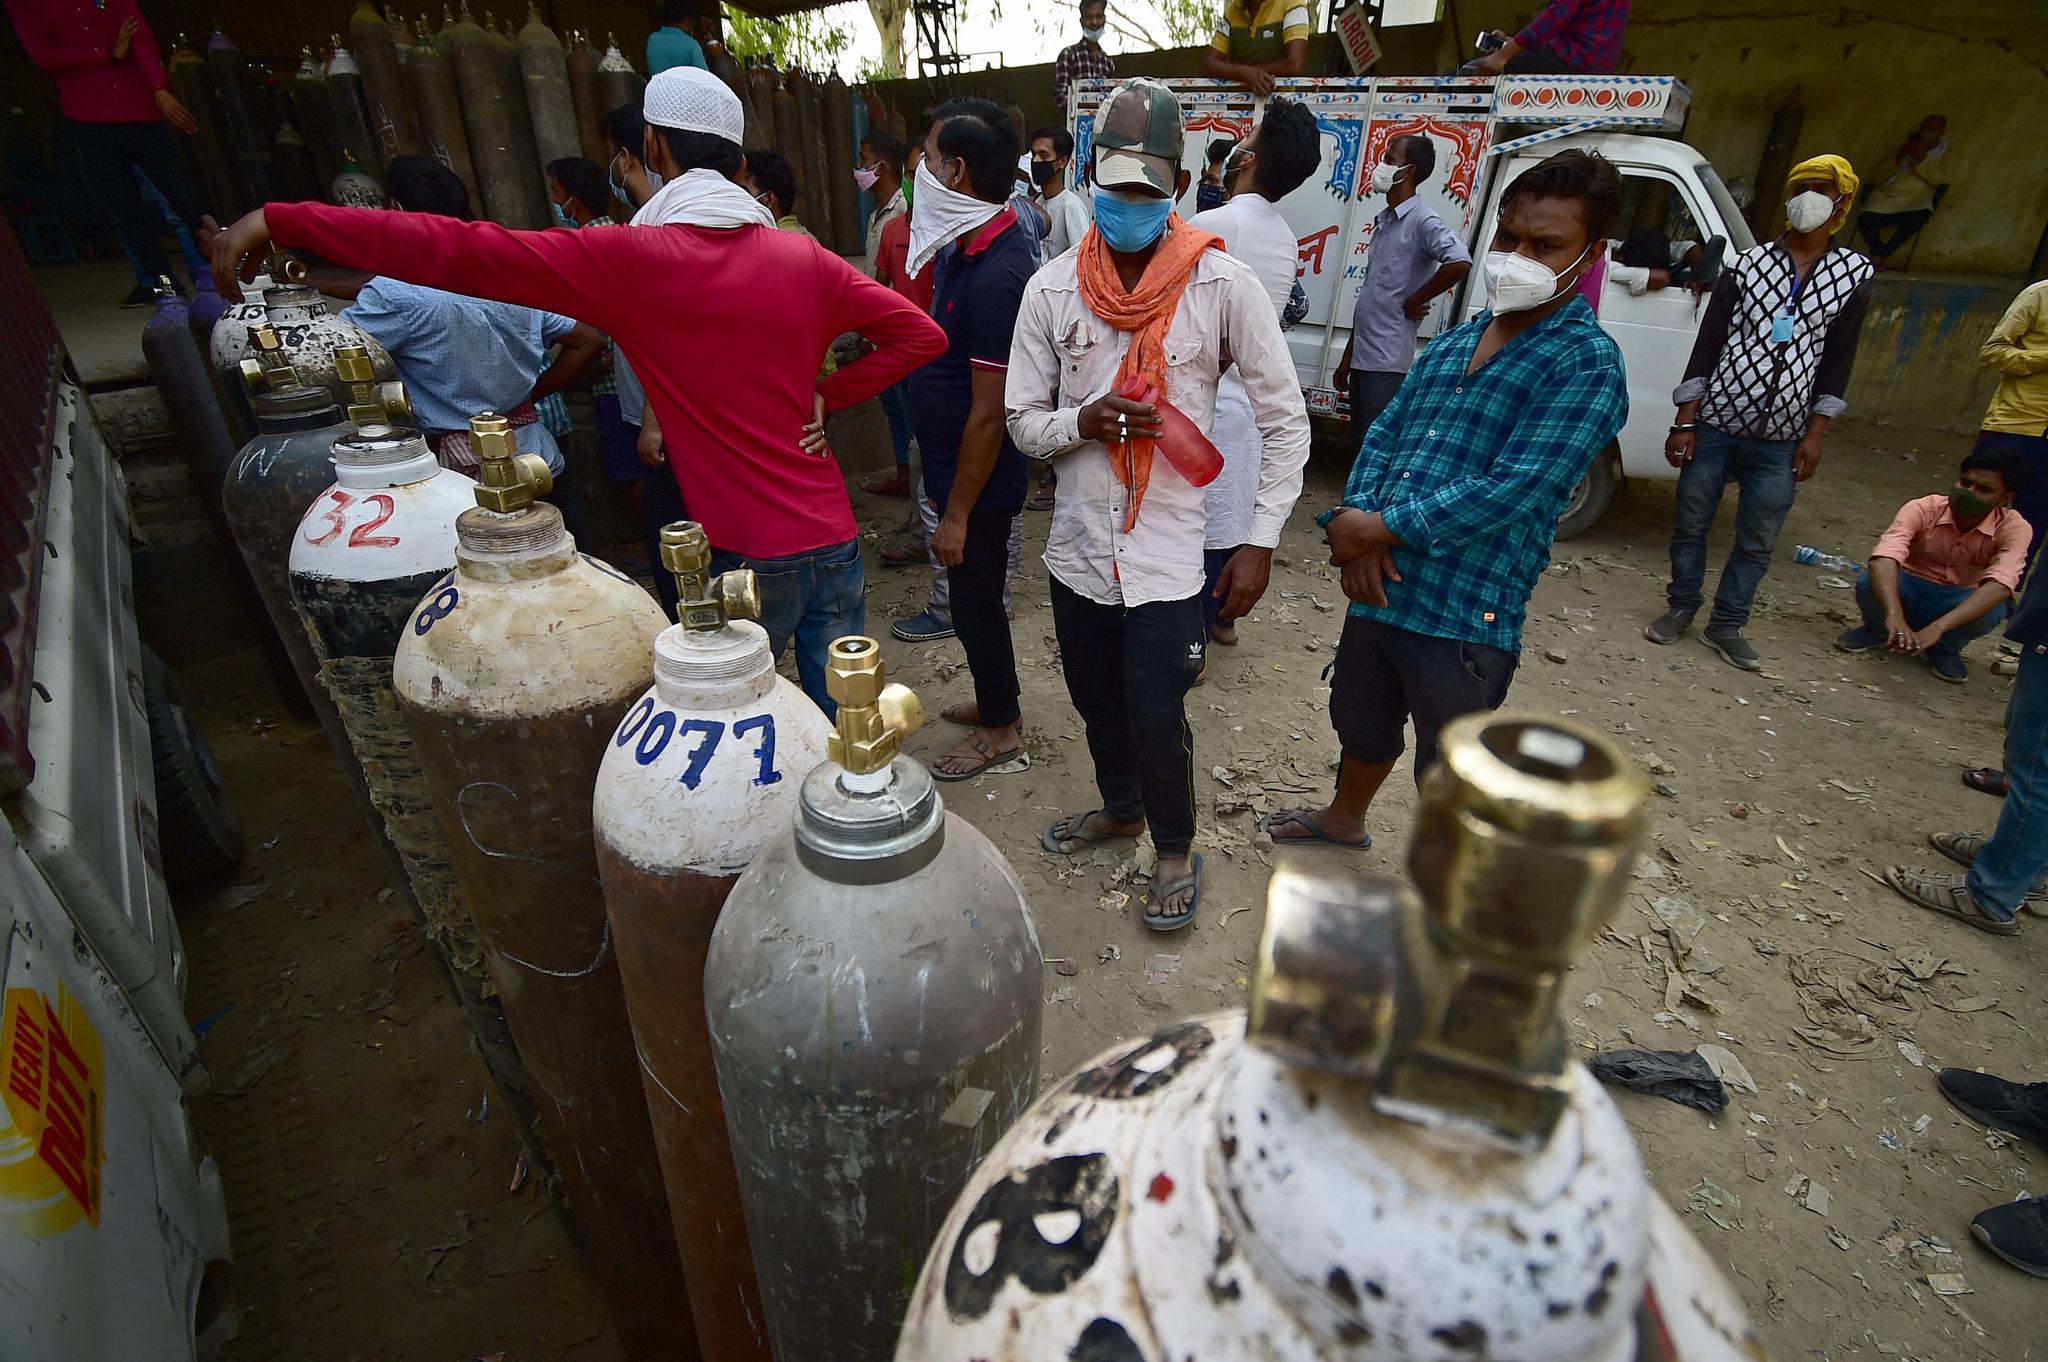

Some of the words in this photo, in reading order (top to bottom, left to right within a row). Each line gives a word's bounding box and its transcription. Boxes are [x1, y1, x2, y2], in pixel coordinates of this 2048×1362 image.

[1340, 11, 1376, 68] ARGON
[302, 485, 401, 548] 32
[616, 697, 783, 791] 0077
[9, 1004, 44, 1113] HEAVY
[38, 1000, 90, 1217] DUTY
